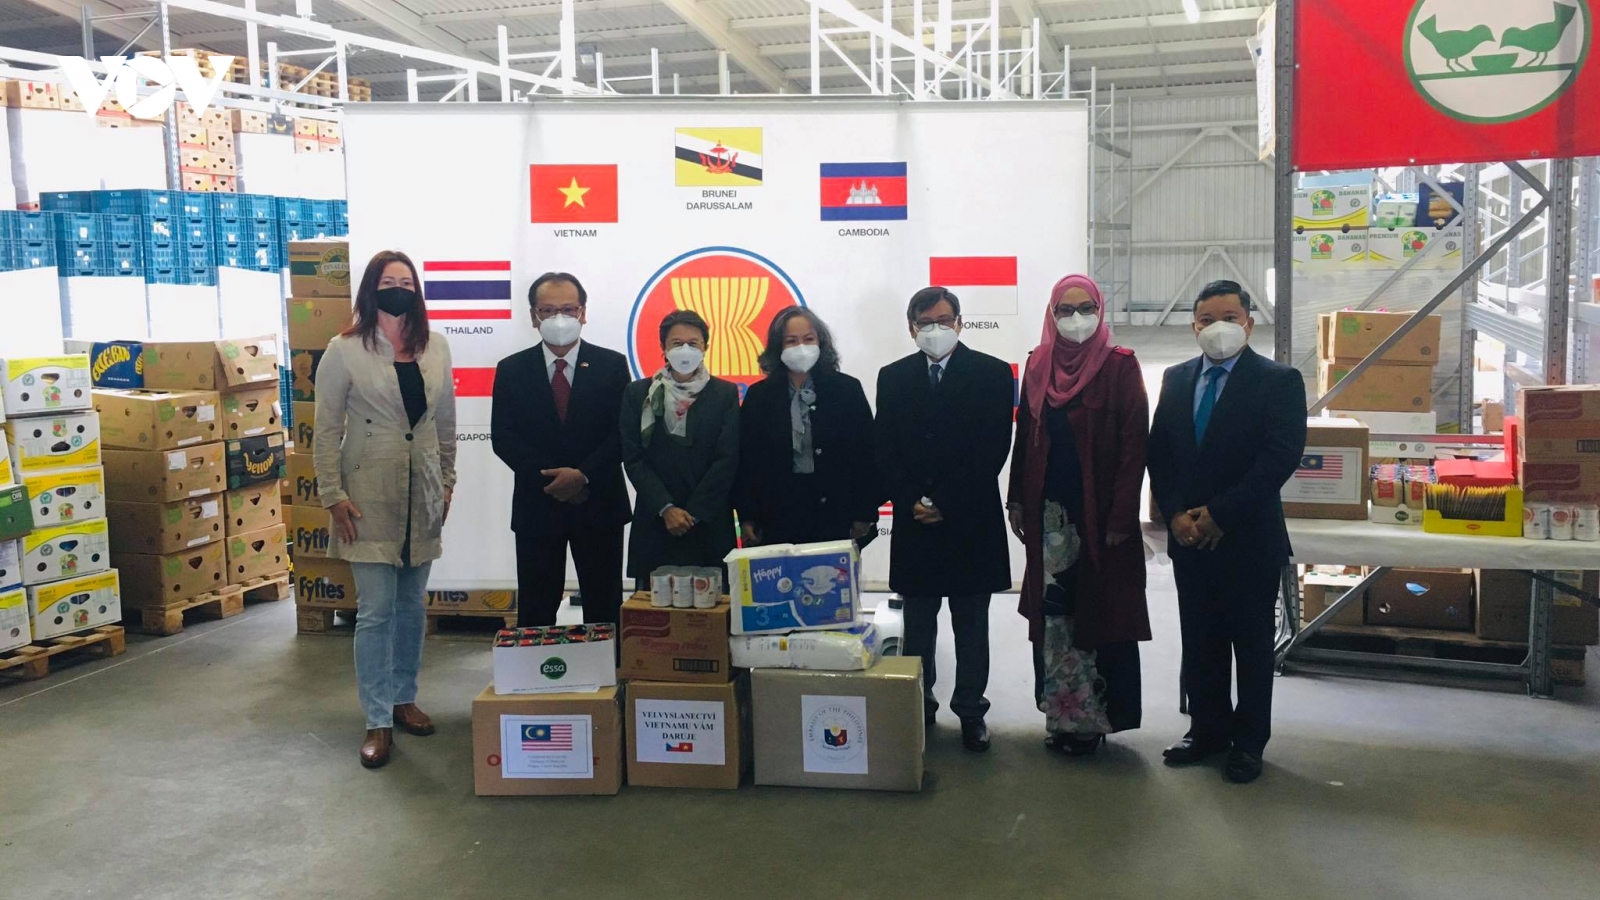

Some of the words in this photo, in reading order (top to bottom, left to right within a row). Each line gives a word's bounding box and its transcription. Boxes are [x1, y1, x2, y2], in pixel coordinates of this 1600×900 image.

[702, 190, 737, 198] BRUNEI
[686, 202, 753, 210] DARUSSALAM
[553, 229, 597, 237] VIETNAM
[838, 228, 890, 236] CAMBODIA
[962, 321, 999, 330] ONESIA
[444, 326, 494, 335] THAILAND
[456, 433, 492, 441] GAPOR
[756, 605, 770, 626] 3
[642, 711, 716, 720] VELVYSLANECTVÍ
[645, 721, 691, 730] VIETNAMU
[694, 723, 714, 731] VÁM
[662, 732, 696, 740] DARUJE
